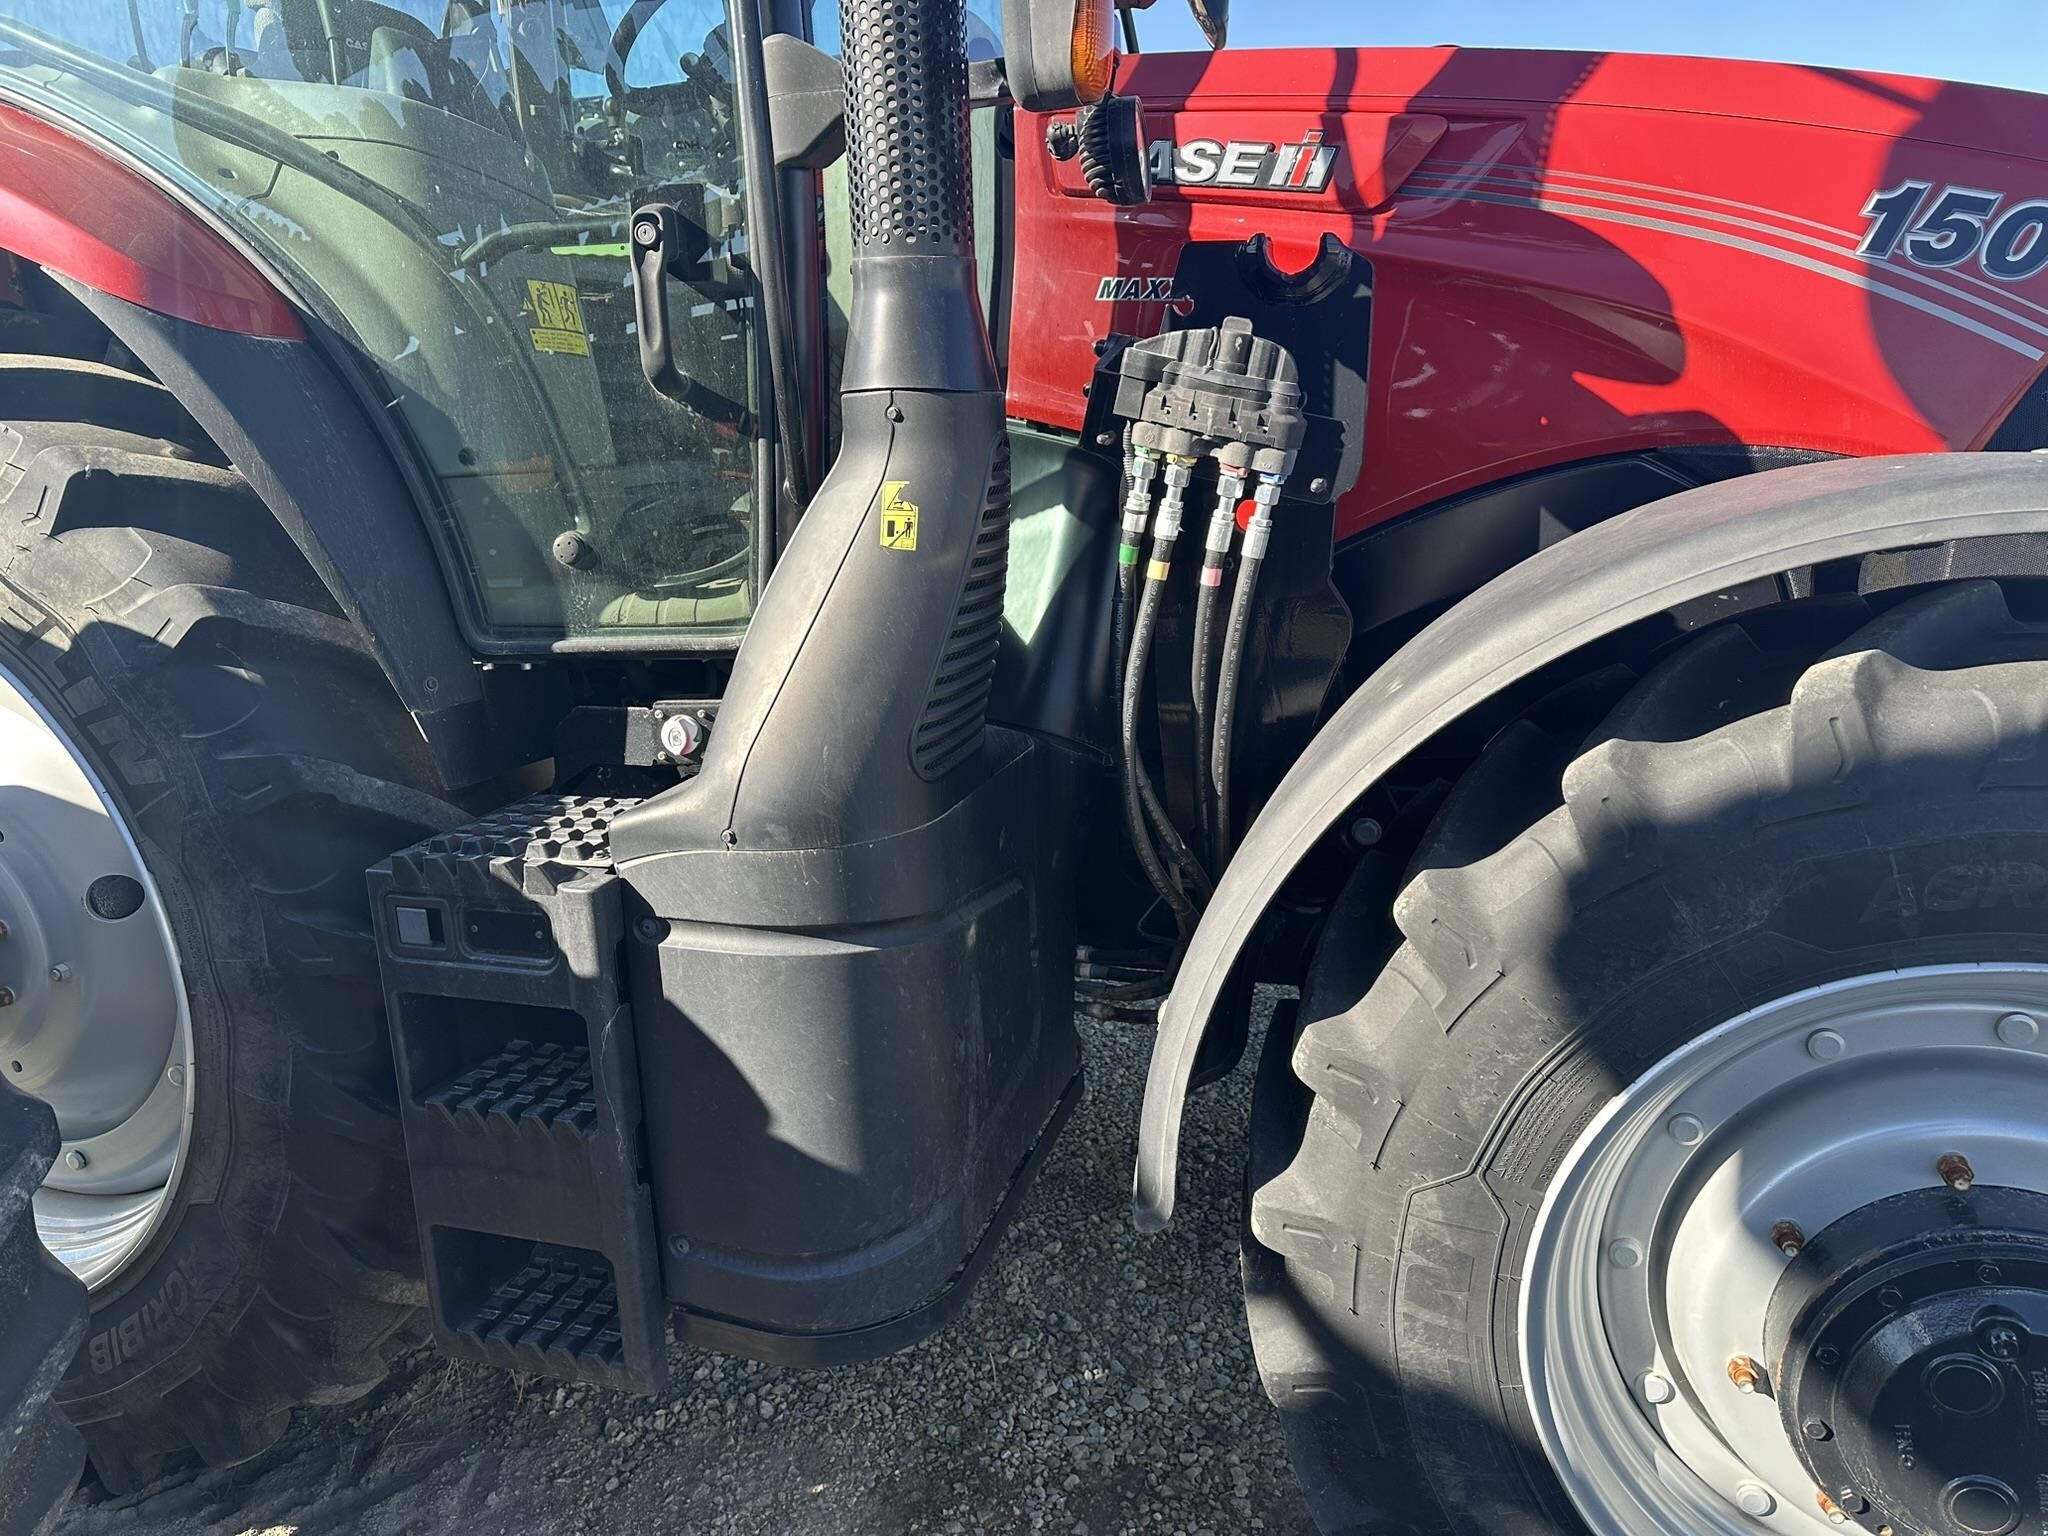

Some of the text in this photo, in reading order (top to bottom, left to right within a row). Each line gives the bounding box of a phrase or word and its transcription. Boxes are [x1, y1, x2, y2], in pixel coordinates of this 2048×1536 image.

[345, 38, 368, 51] CAS
[1150, 138, 1272, 185] ASE
[1853, 177, 2048, 282] 150
[1857, 861, 2048, 924] AGR
[1571, 1102, 1600, 1131] GROOVE
